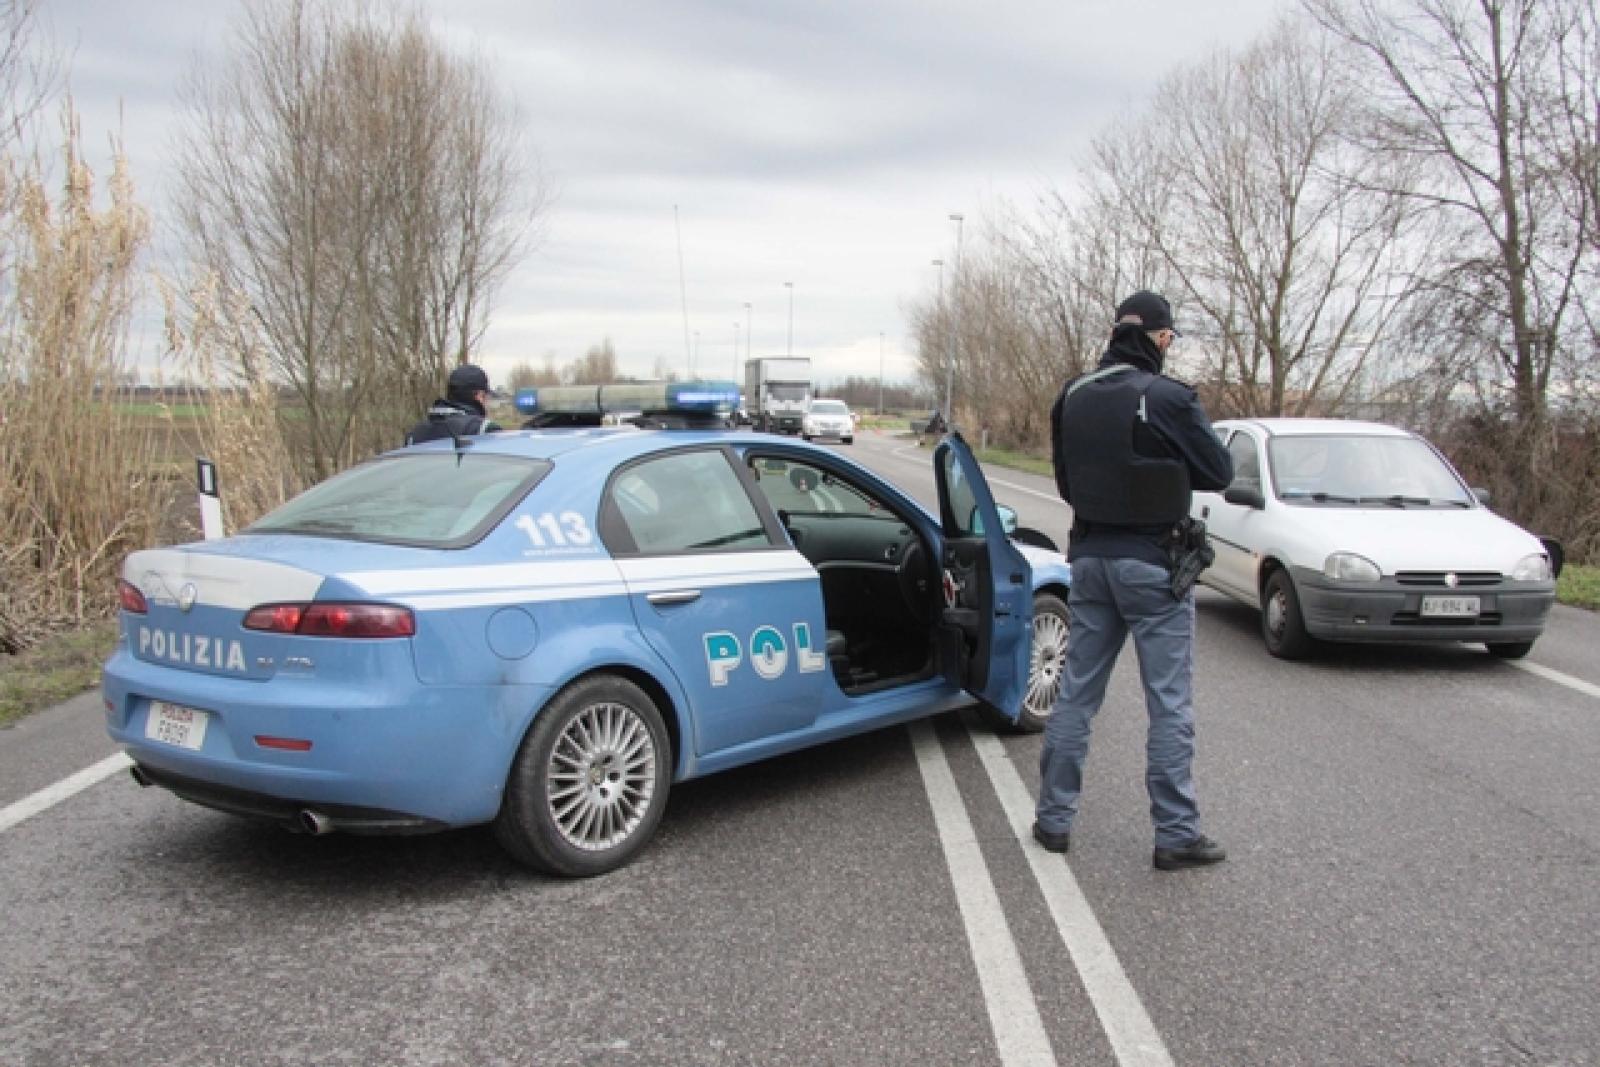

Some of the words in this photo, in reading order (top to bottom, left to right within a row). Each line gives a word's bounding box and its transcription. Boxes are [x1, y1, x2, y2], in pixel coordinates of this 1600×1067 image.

[515, 510, 592, 547] 113
[138, 627, 246, 672] POLIZIA
[702, 622, 826, 687] POL
